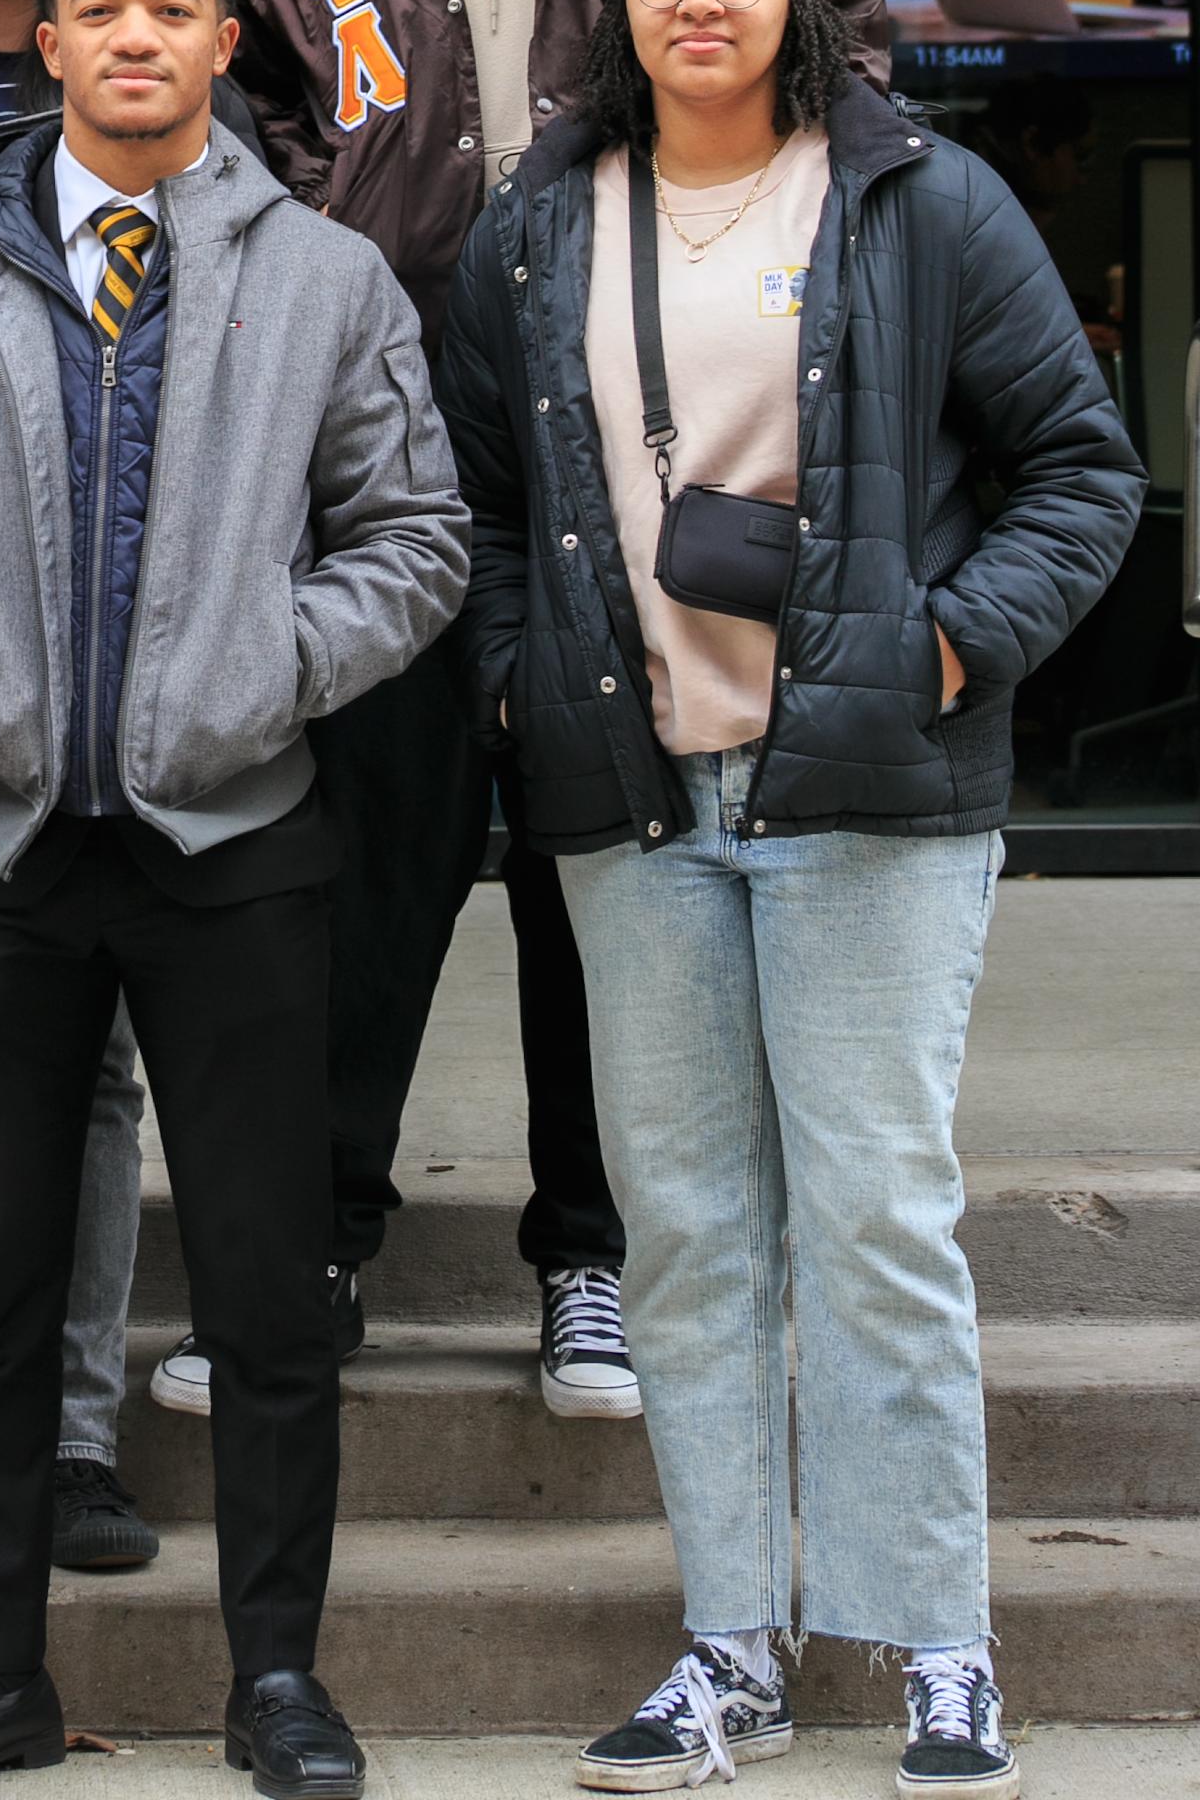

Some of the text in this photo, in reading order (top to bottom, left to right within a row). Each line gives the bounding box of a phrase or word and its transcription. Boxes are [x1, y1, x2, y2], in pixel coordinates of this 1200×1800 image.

[915, 46, 1005, 67] 11:54AM
[764, 273, 783, 282] MLK
[764, 282, 783, 291] DAY
